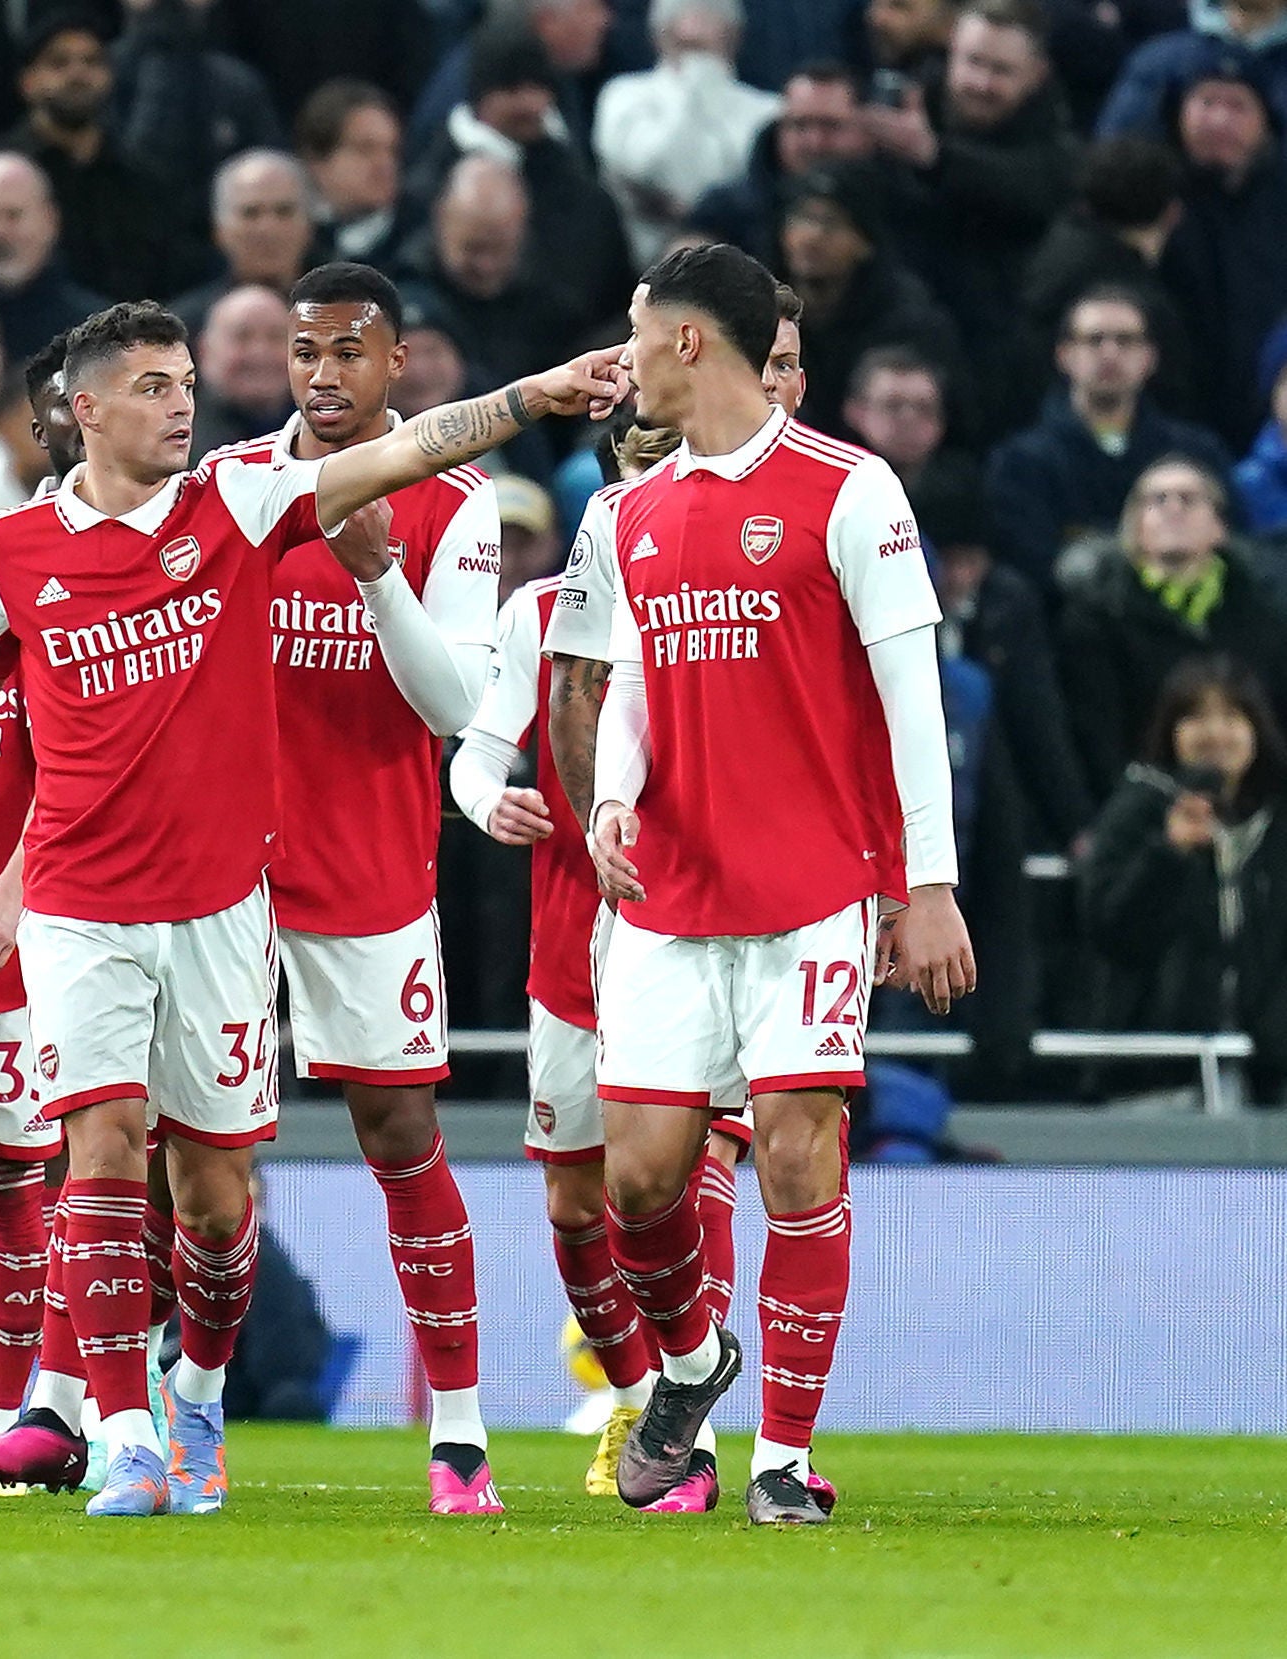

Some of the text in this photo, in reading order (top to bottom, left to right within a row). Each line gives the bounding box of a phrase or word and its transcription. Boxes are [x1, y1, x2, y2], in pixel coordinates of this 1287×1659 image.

[40, 588, 222, 668] Emirates
[686, 626, 759, 662] BETTER
[79, 633, 203, 698] FLY BETTER
[289, 637, 374, 671] BETTER
[401, 958, 434, 1023] 6
[798, 961, 858, 1026] 12
[399, 1261, 454, 1277] AFC
[4, 1288, 44, 1305] AF
[86, 1278, 144, 1298] AFC
[768, 1319, 827, 1343] AFC
